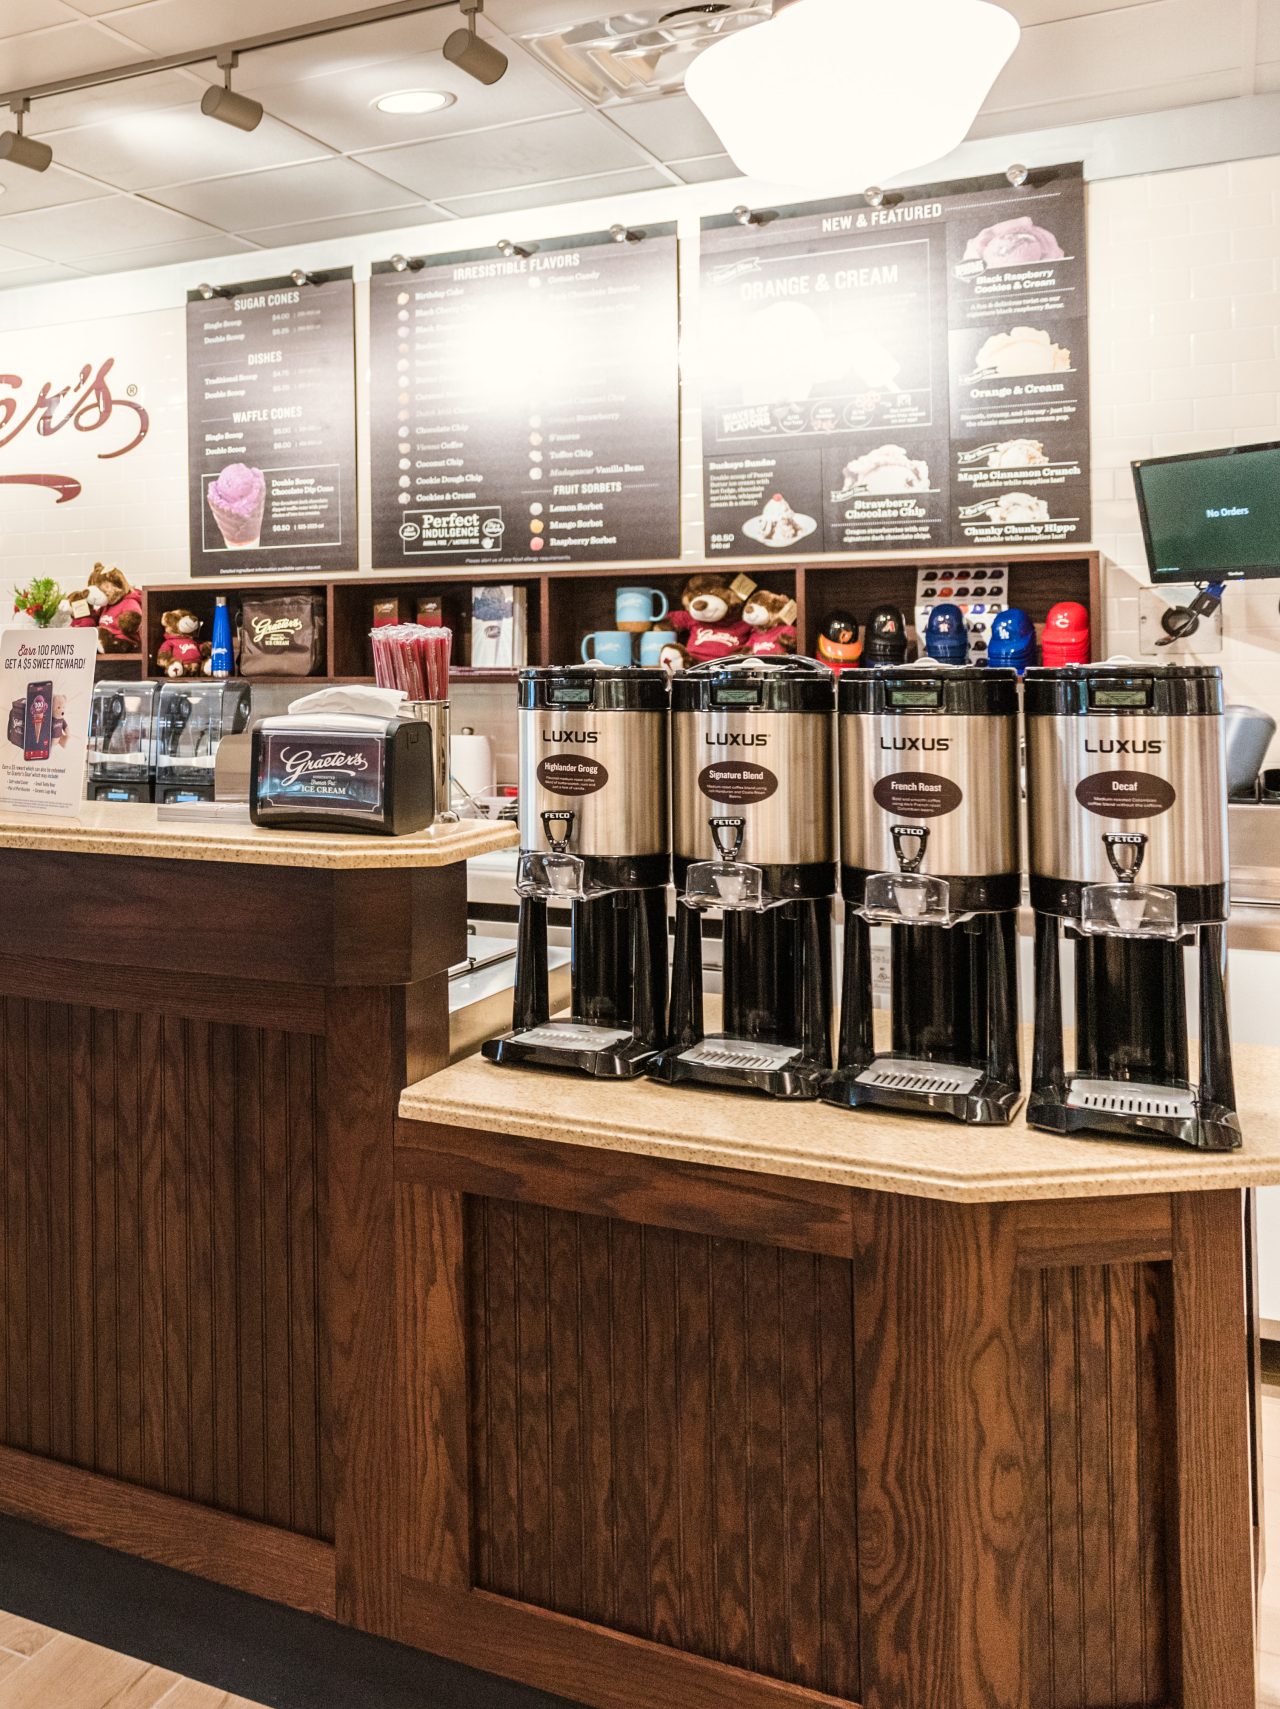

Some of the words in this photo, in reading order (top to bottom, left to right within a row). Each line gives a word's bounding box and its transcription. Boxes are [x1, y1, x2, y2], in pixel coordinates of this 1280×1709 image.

[822, 216, 852, 232] NEW
[856, 214, 868, 228] &
[872, 203, 941, 226] FEATURED
[453, 260, 527, 280] IRRESISTIBLE
[530, 253, 580, 271] FLAVORS
[575, 270, 600, 280] Candy
[976, 275, 1002, 284] Black
[1004, 270, 1054, 281] Raspberry
[741, 275, 810, 301] ORANGE
[815, 273, 830, 292] &
[835, 265, 898, 290] CREAM
[975, 283, 1011, 294] Cookies
[1023, 279, 1055, 289] Cream
[415, 291, 445, 300] Birthday
[235, 297, 265, 311] SUGAR
[268, 292, 300, 305] CONES
[204, 336, 225, 344] Double
[226, 334, 245, 342] Scoop
[248, 351, 282, 365] DISHES
[205, 375, 239, 385] Traditional
[205, 392, 226, 400] Double
[970, 387, 1012, 398] Orange
[1013, 386, 1023, 395] &
[1025, 383, 1064, 393] Cream
[233, 409, 269, 423] WAFFLE
[271, 406, 302, 419] CONES
[576, 413, 619, 422] Strawberry
[451, 424, 469, 432] Chip
[441, 441, 463, 449] Coffee
[574, 449, 593, 458] Chip
[416, 460, 445, 468] Coconut
[446, 458, 464, 467] Chip
[709, 461, 743, 470] Buckeye
[744, 458, 776, 467] Sundae
[595, 466, 623, 474] Vanilla
[958, 473, 988, 481] Maple
[990, 470, 1041, 479] Cinnamon
[1042, 466, 1080, 476] Crunch
[272, 479, 294, 487] Double
[295, 478, 315, 486] Scoop
[416, 477, 440, 485] Cookie
[442, 475, 464, 484] Dough
[465, 474, 483, 482] Chip
[1023, 477, 1049, 485] supplies
[272, 487, 303, 496] Chocolate
[305, 486, 316, 495] Dip
[553, 484, 579, 495] FRUIT
[581, 482, 622, 493] SORBETS
[577, 503, 603, 511] Sorbet
[854, 499, 916, 509] Strawberry
[845, 508, 898, 519] Chocolate
[900, 506, 926, 517] Chip
[1206, 509, 1219, 518] No
[1221, 507, 1249, 516] Orders
[422, 513, 479, 528] Perfect
[550, 522, 576, 530] Mango
[577, 519, 603, 528] Sorbet
[422, 527, 479, 538] INDULGENCE
[964, 527, 1003, 536] Chunky
[1004, 525, 1043, 534] Chunky
[1044, 524, 1076, 533] Hippo
[550, 538, 589, 546] Raspberry
[590, 536, 617, 544] Sorbet
[1024, 533, 1051, 541] supplies
[18, 645, 37, 656] Earn
[38, 645, 49, 655] 100
[51, 645, 74, 655] POINTS
[5, 659, 17, 669] GET
[18, 659, 22, 669] A
[23, 658, 31, 670] $5
[32, 659, 54, 669] SWEET
[56, 658, 86, 669] REWARD!
[543, 730, 598, 743] LUXUS
[706, 733, 767, 746] LUXUS
[881, 737, 949, 751] LUXUS
[1085, 739, 1161, 754] LUXUS
[280, 746, 368, 786] Graeter's
[545, 762, 576, 772] Highlander
[578, 764, 598, 774] Grogg
[709, 770, 741, 780] Signature
[743, 771, 763, 779] Blend
[317, 786, 346, 794] CREAM
[891, 781, 917, 791] French
[919, 783, 942, 792] Roast
[1112, 781, 1137, 791] Decaf
